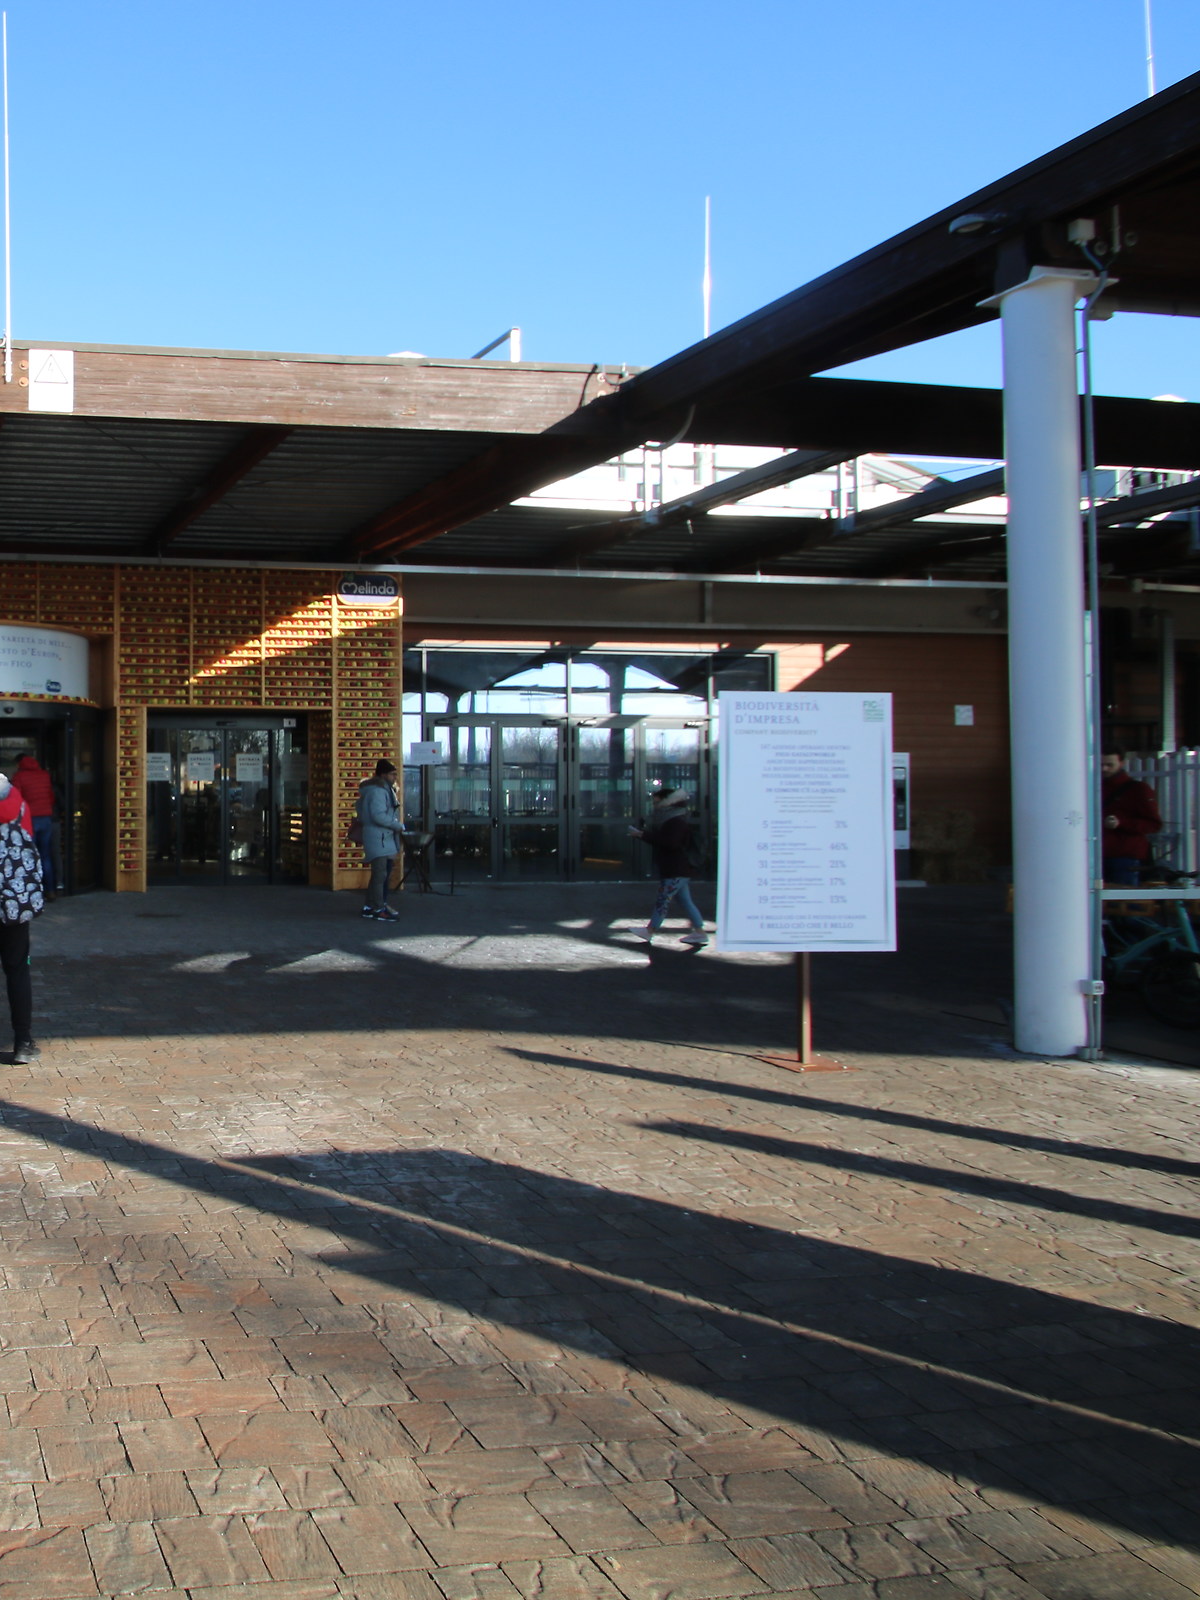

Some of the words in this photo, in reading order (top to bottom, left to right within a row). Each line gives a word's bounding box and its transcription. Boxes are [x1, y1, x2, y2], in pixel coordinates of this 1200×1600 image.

[341, 580, 395, 595] Melinda
[11, 660, 33, 668] FICO
[735, 699, 820, 712] BIODIVERSITÀ
[735, 713, 801, 724] D'IMPRESA
